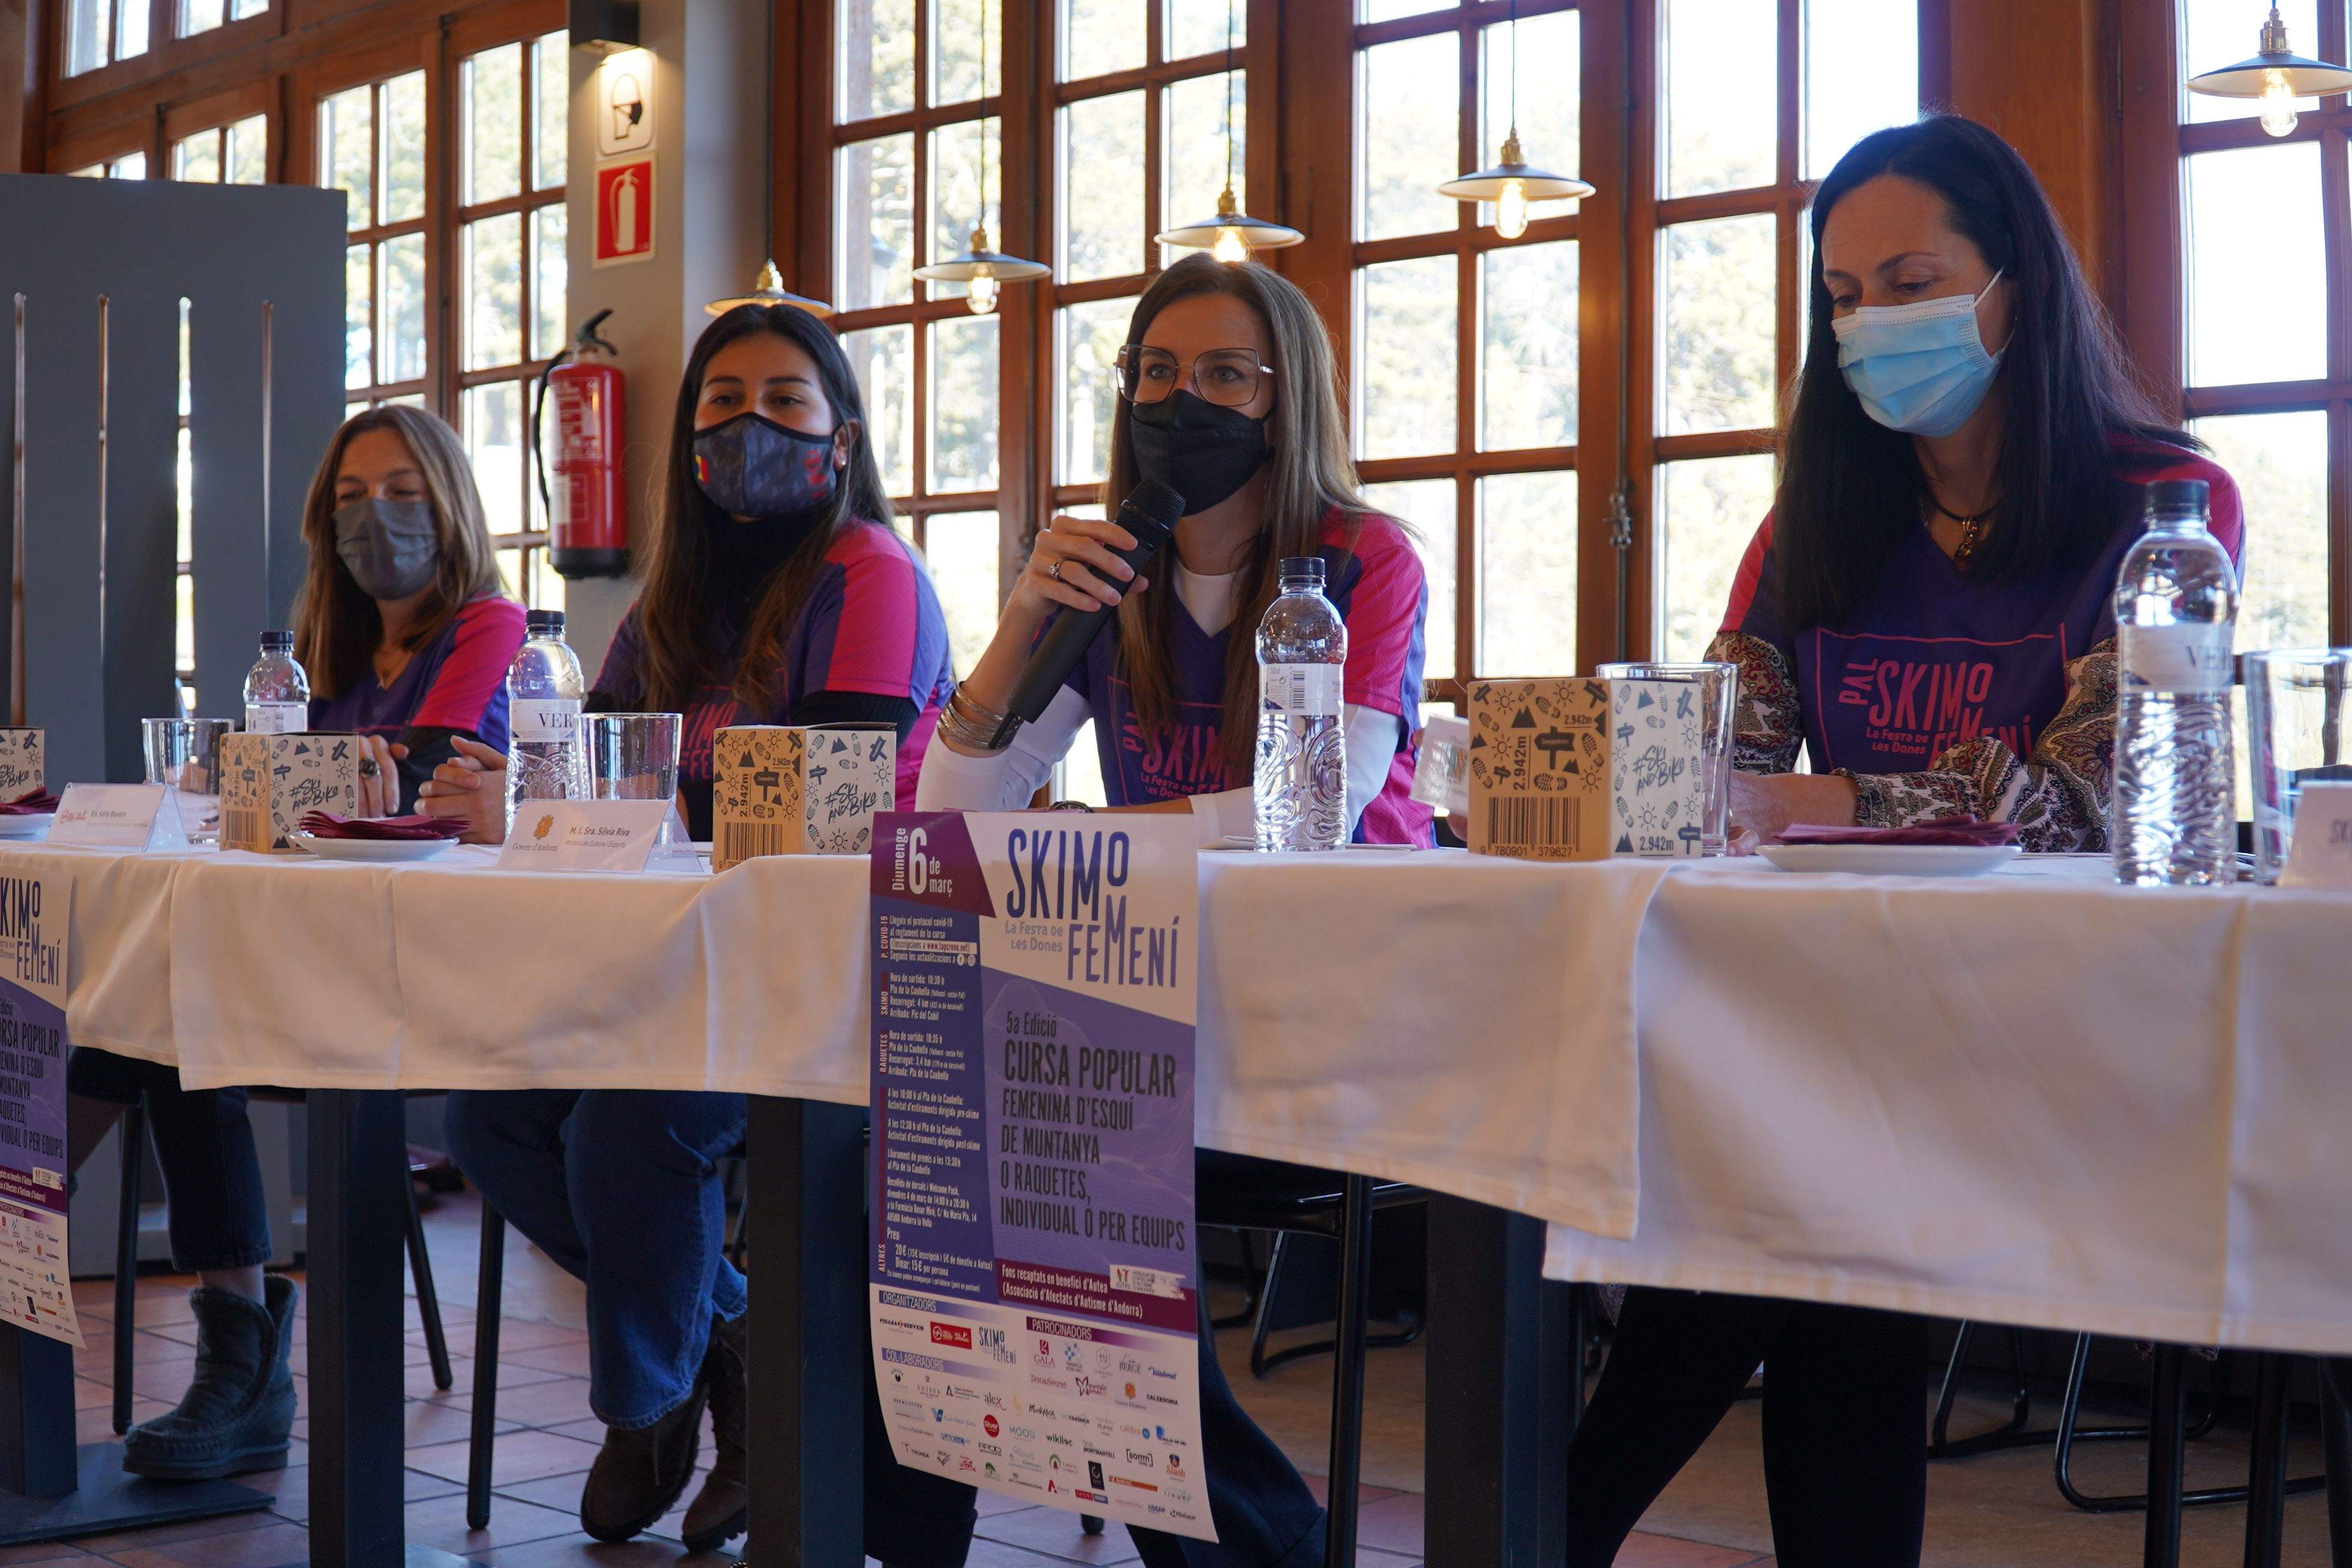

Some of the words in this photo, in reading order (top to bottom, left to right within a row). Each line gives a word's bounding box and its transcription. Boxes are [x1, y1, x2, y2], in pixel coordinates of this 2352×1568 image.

[1838, 659, 1878, 705] PAL
[1869, 660, 1993, 731] SKIMO
[1564, 714, 1592, 725] 2.942m
[1892, 743, 1927, 755] Dones
[1513, 735, 1527, 791] 2.942m
[740, 773, 749, 817] 2.942m
[584, 827, 596, 835] Sra.
[615, 828, 630, 836] Riva
[1640, 837, 1674, 853] 2.942m
[892, 827, 906, 891] Diumenge
[908, 827, 927, 894] 6
[929, 856, 941, 875] de
[1480, 846, 1487, 855] 9
[1494, 846, 1528, 856] 780901
[1538, 847, 1573, 858] 379627
[929, 877, 953, 897] març
[1007, 828, 1129, 921] SKIMO
[0, 877, 41, 939] KIMO
[890, 916, 906, 926] Llegeix
[913, 917, 932, 926] protocol
[934, 917, 953, 927] covid-19
[896, 929, 919, 938] reglament
[1004, 921, 1016, 934] La
[1068, 894, 1180, 988] FEMENÍ
[17, 923, 60, 986] FEMENÍ
[890, 951, 908, 961] Segueix
[1030, 940, 1062, 953] Dones
[890, 973, 901, 982] Hora
[1007, 1011, 1019, 1034] 5a
[1024, 1012, 1056, 1037] Edició
[0, 1019, 18, 1049] RSA
[22, 1022, 59, 1058] POPULAR
[880, 1033, 888, 1073] RAQUETES
[1004, 1039, 1070, 1087] CURSA
[1079, 1046, 1176, 1097] POPULAR
[0, 1099, 27, 1128] AQUETES,
[1003, 1088, 1071, 1123] FEMENINA
[1077, 1097, 1134, 1131] D'ESQUÍ
[24, 1129, 27, 1149] O
[29, 1132, 40, 1153] PER
[42, 1135, 63, 1159] EQUIPS
[1002, 1125, 1018, 1153] DE
[1024, 1127, 1100, 1164] MUNTANYA
[1002, 1160, 1009, 1189] O
[1015, 1163, 1091, 1205] RAQUETES,
[1001, 1196, 1079, 1236] INDIVIDUAL
[1085, 1208, 1093, 1238] O
[1100, 1211, 1125, 1242] PER
[1132, 1215, 1185, 1251] EQUIPS
[896, 1257, 911, 1270] Dinar:
[932, 1266, 949, 1276] persona
[1002, 1264, 1015, 1278] Fons
[1017, 1269, 1046, 1283] recaptats
[1048, 1275, 1055, 1284] en
[1056, 1275, 1081, 1288] benefici
[1083, 1277, 1107, 1293] d'Autea
[883, 1292, 936, 1312] ORGANITZADORS
[1003, 1282, 1038, 1300] (Associació
[1040, 1287, 1073, 1306] d'Afectats
[1074, 1293, 1106, 1311] d'Autisme
[1108, 1299, 1143, 1319] d'Andorra)
[979, 1327, 1004, 1347] SKIMO
[1032, 1319, 1092, 1339] PATROCINADORS
[1034, 1354, 1055, 1366] GALA
[1009, 1426, 1035, 1438] MOOD
[1046, 1434, 1073, 1446] wikiloc
